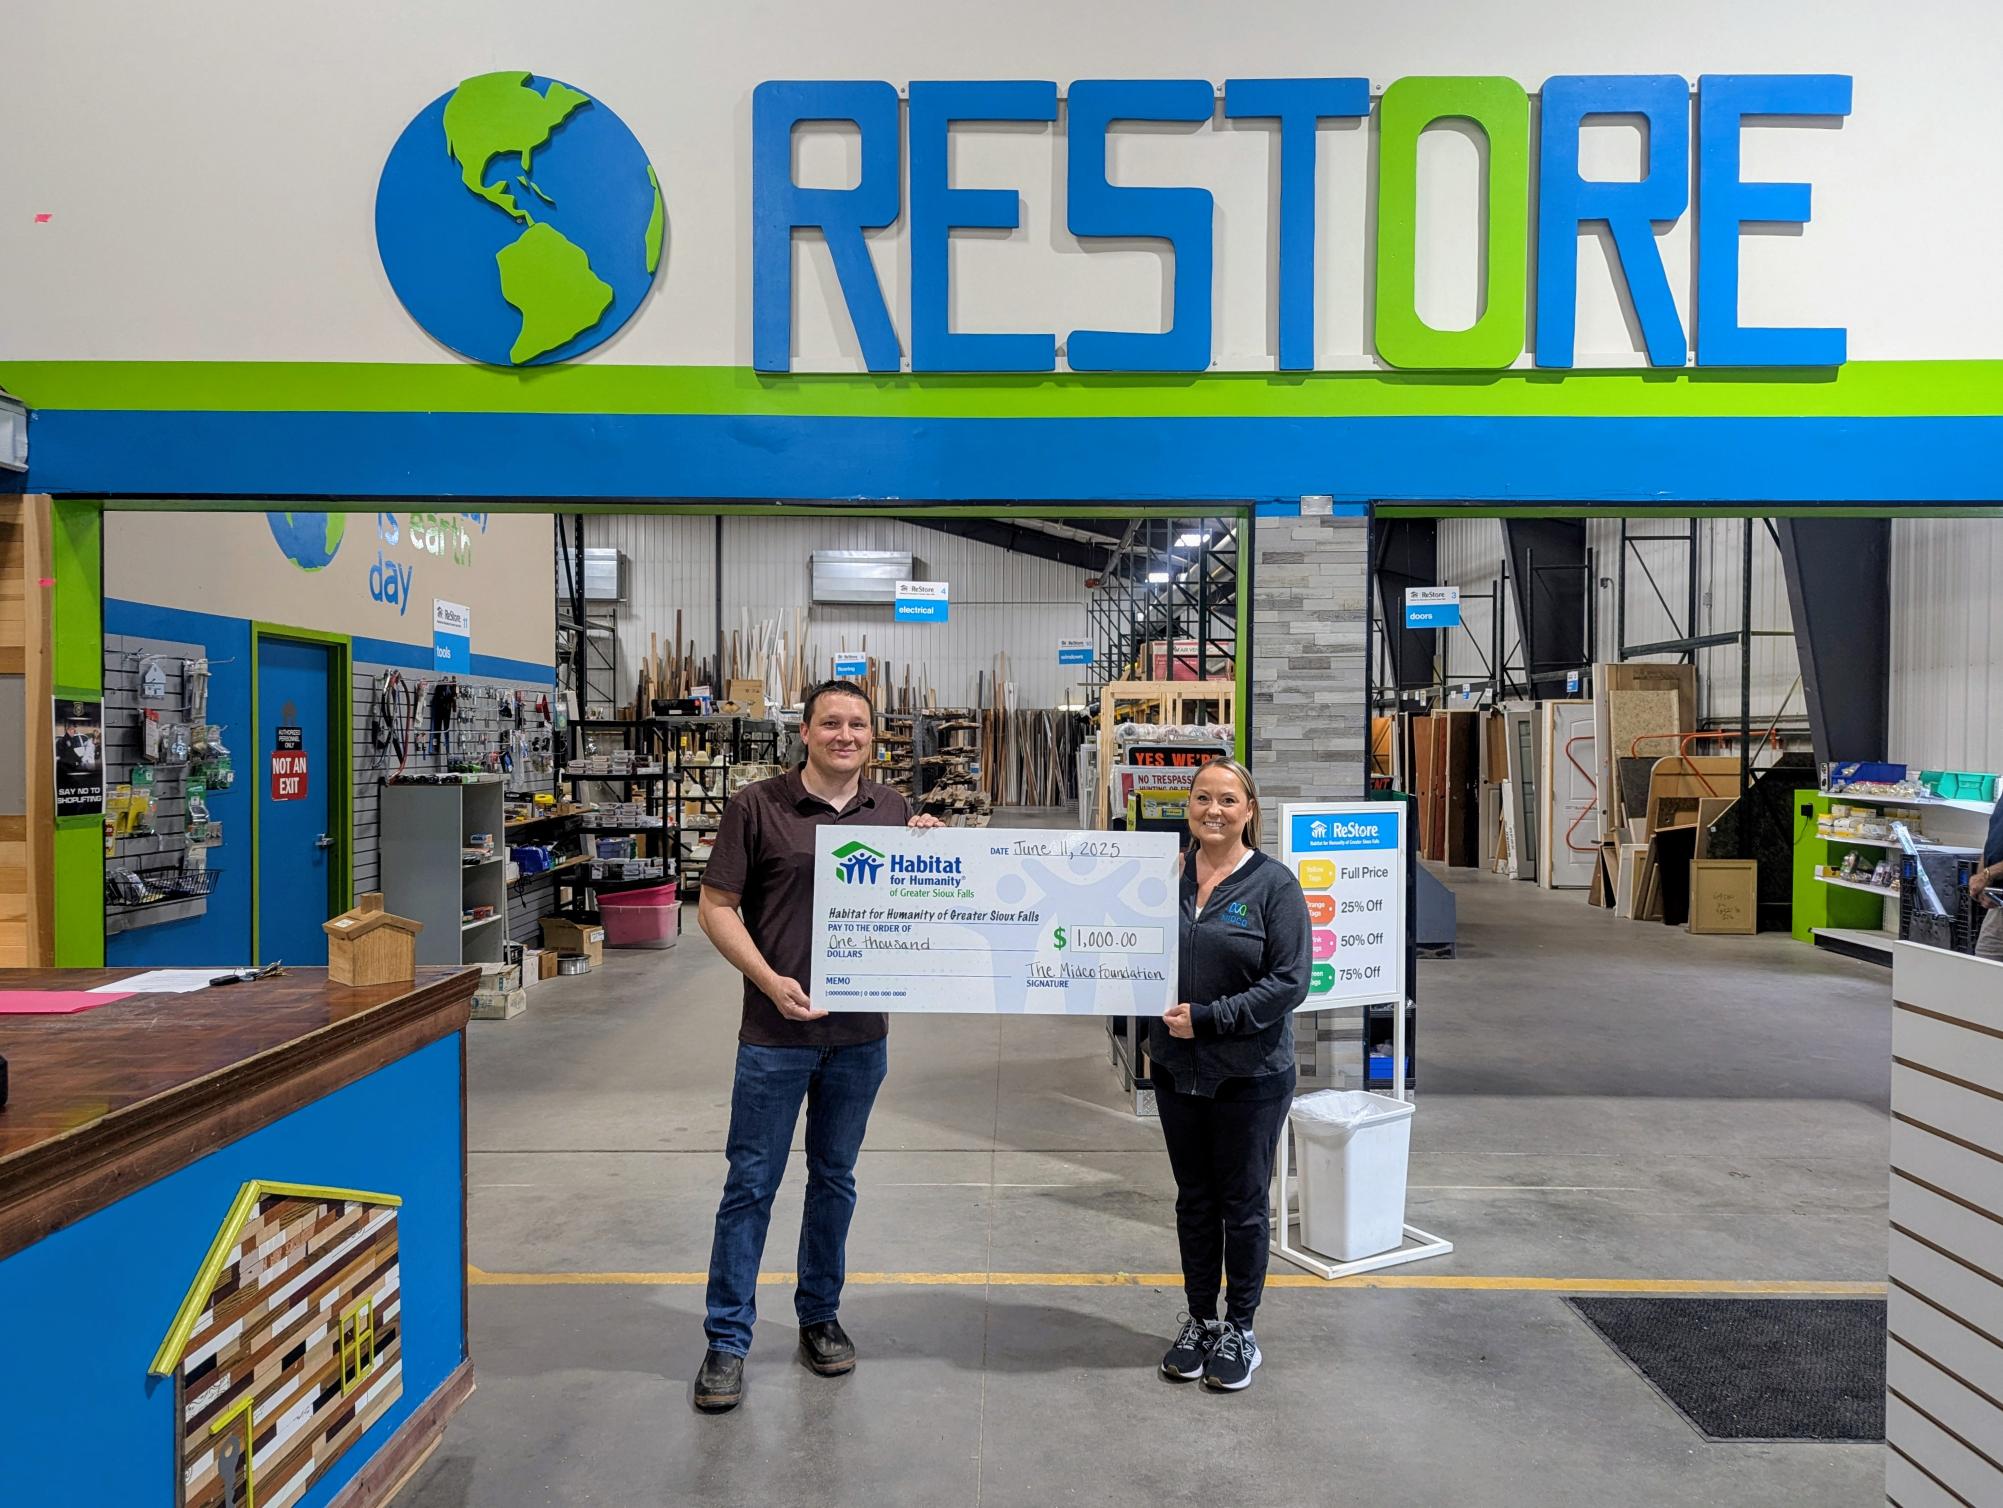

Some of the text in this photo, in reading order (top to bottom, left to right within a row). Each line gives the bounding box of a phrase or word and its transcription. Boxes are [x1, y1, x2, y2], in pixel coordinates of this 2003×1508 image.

[753, 74, 1852, 374] RESTORE
[369, 549, 413, 617] day
[911, 585, 935, 593] ReStore
[940, 587, 947, 595] 4
[1451, 591, 1457, 600] 3
[898, 606, 935, 615] electrical
[1410, 612, 1433, 620] doors
[462, 617, 468, 629] 11
[436, 645, 451, 659] tools
[272, 757, 307, 775] NOT AN
[1135, 752, 1165, 766] YES
[279, 777, 300, 795] EXIT
[1137, 774, 1149, 784] NO
[58, 786, 101, 796] SAY NO TO
[57, 795, 102, 805] SHOPLIFTING
[1333, 822, 1379, 838] ReStore
[990, 847, 1009, 856] DATE
[1013, 840, 1051, 857] June
[1079, 841, 1121, 858] 2025
[890, 854, 962, 874] Habitat
[1341, 866, 1389, 880] Full Price
[890, 875, 905, 886] for
[889, 888, 975, 899] of Greater Sioux Falls
[1341, 899, 1383, 914] 25% Off
[828, 907, 1040, 922] Habitat for Humanity of Greater Sioux Falls
[827, 924, 912, 933] PAY TO THE ORDER OF
[828, 934, 931, 951] One thousand
[1053, 926, 1067, 951] $
[1077, 928, 1138, 948] 1,000.00
[1340, 932, 1384, 947] 50% Off
[826, 950, 863, 958] DOLLARS
[1024, 960, 1166, 981] The Midco Foundation
[1339, 965, 1381, 981] 75% Off
[825, 976, 851, 985] MEMO
[1026, 980, 1069, 988] SIGNATURE
